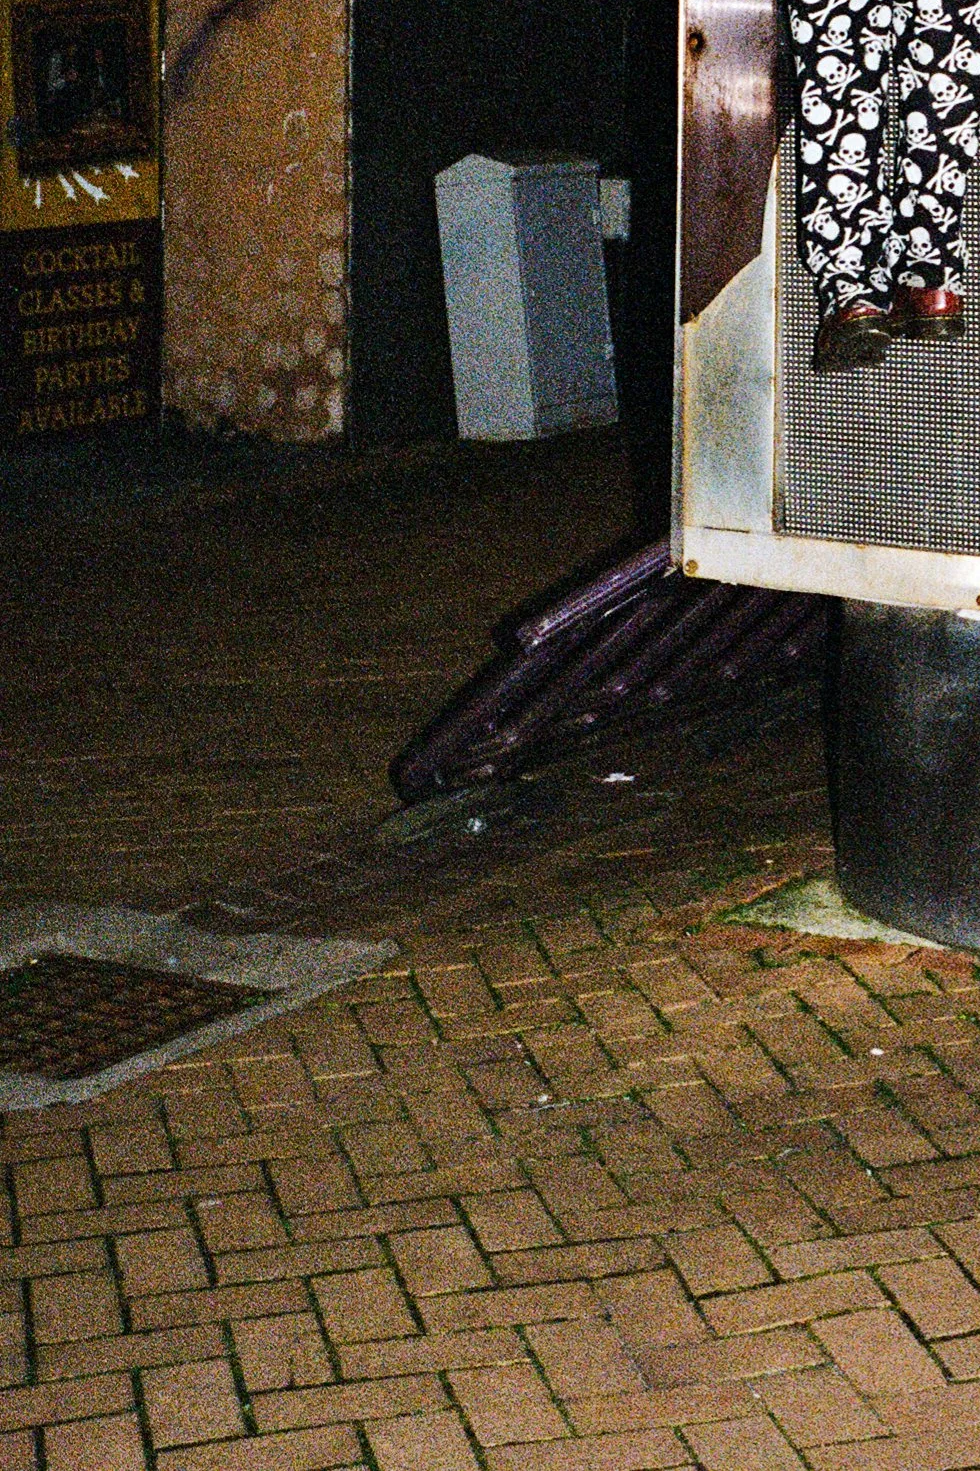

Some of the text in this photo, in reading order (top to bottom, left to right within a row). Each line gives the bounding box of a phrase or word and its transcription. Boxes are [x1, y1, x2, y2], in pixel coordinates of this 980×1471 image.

[22, 241, 143, 277] COCKTAIL
[18, 278, 124, 316] CLASSES
[22, 315, 141, 357] BIRTHDAY
[34, 354, 131, 395] PARTIES
[17, 389, 149, 435] AVAILABLE
